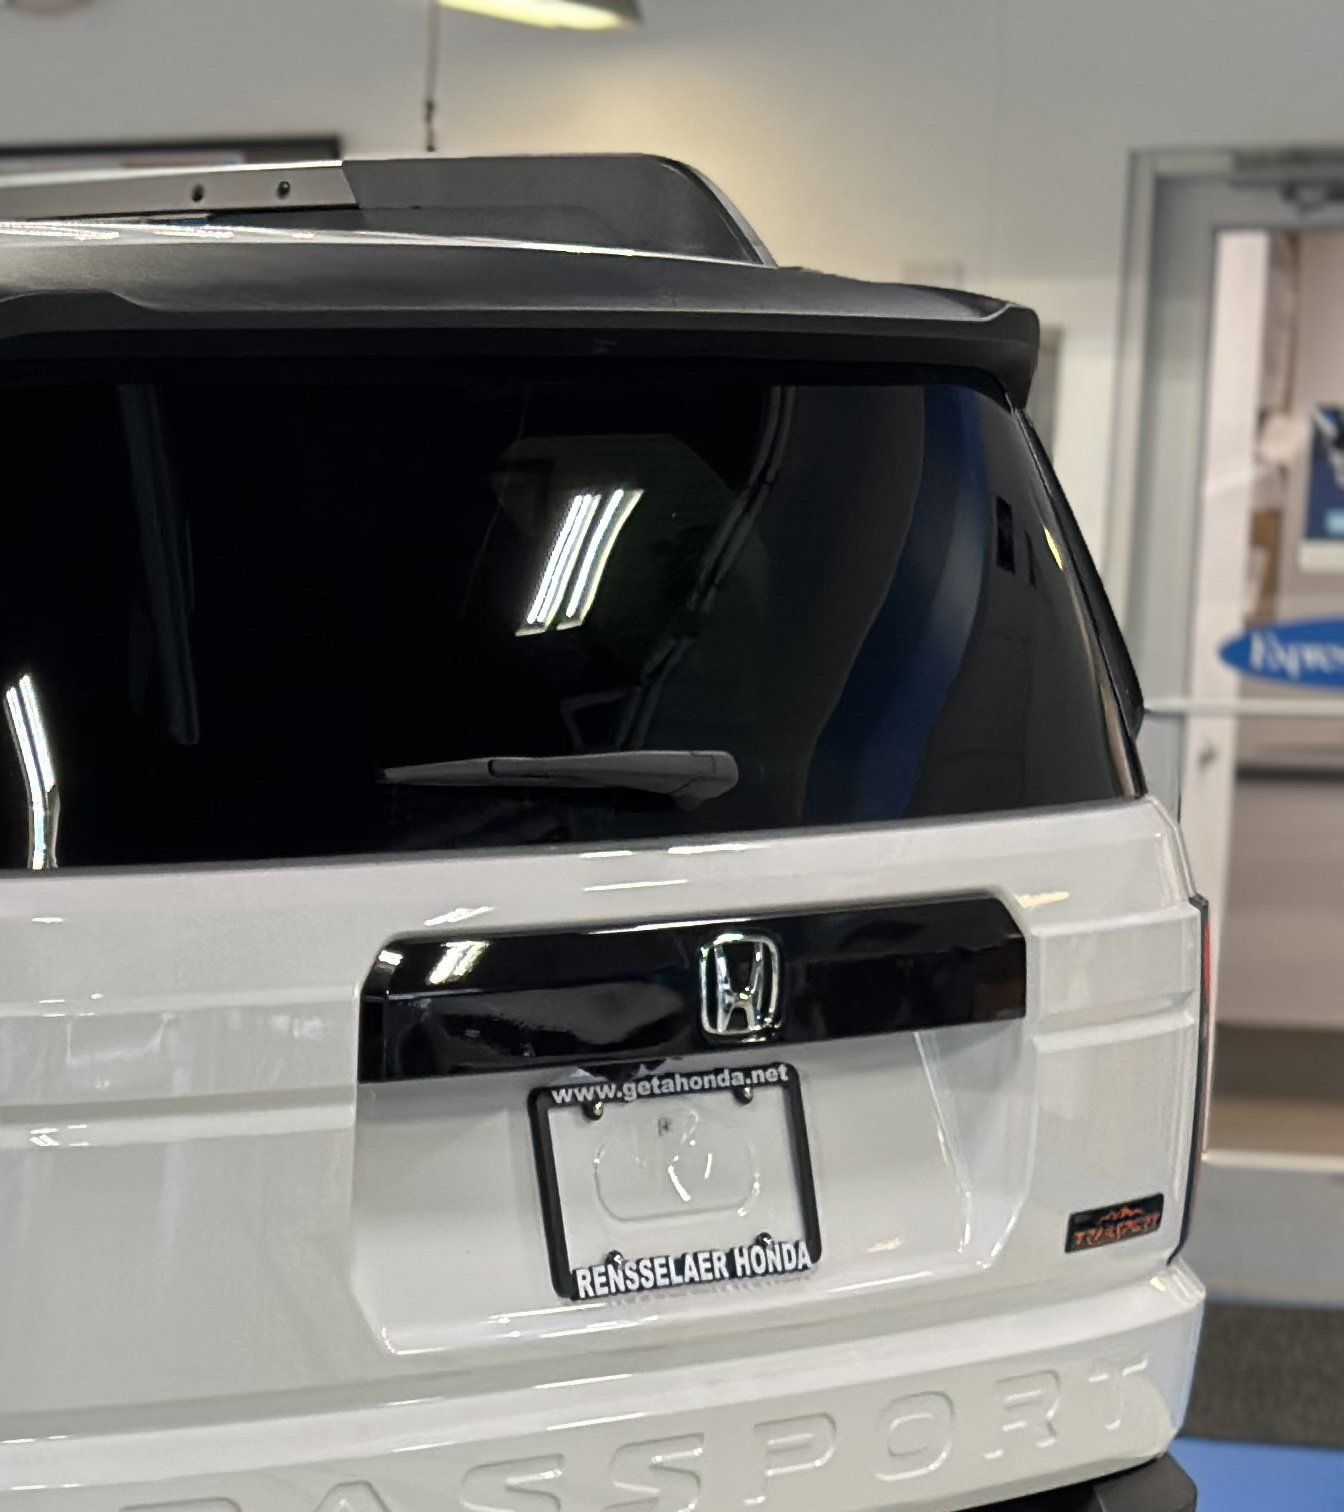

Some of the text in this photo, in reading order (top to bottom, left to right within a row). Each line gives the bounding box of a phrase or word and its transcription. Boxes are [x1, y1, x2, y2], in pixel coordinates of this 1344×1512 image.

[551, 1063, 790, 1104] www.getahonda.net
[575, 1240, 813, 1299] RENSSELAER HONDA
